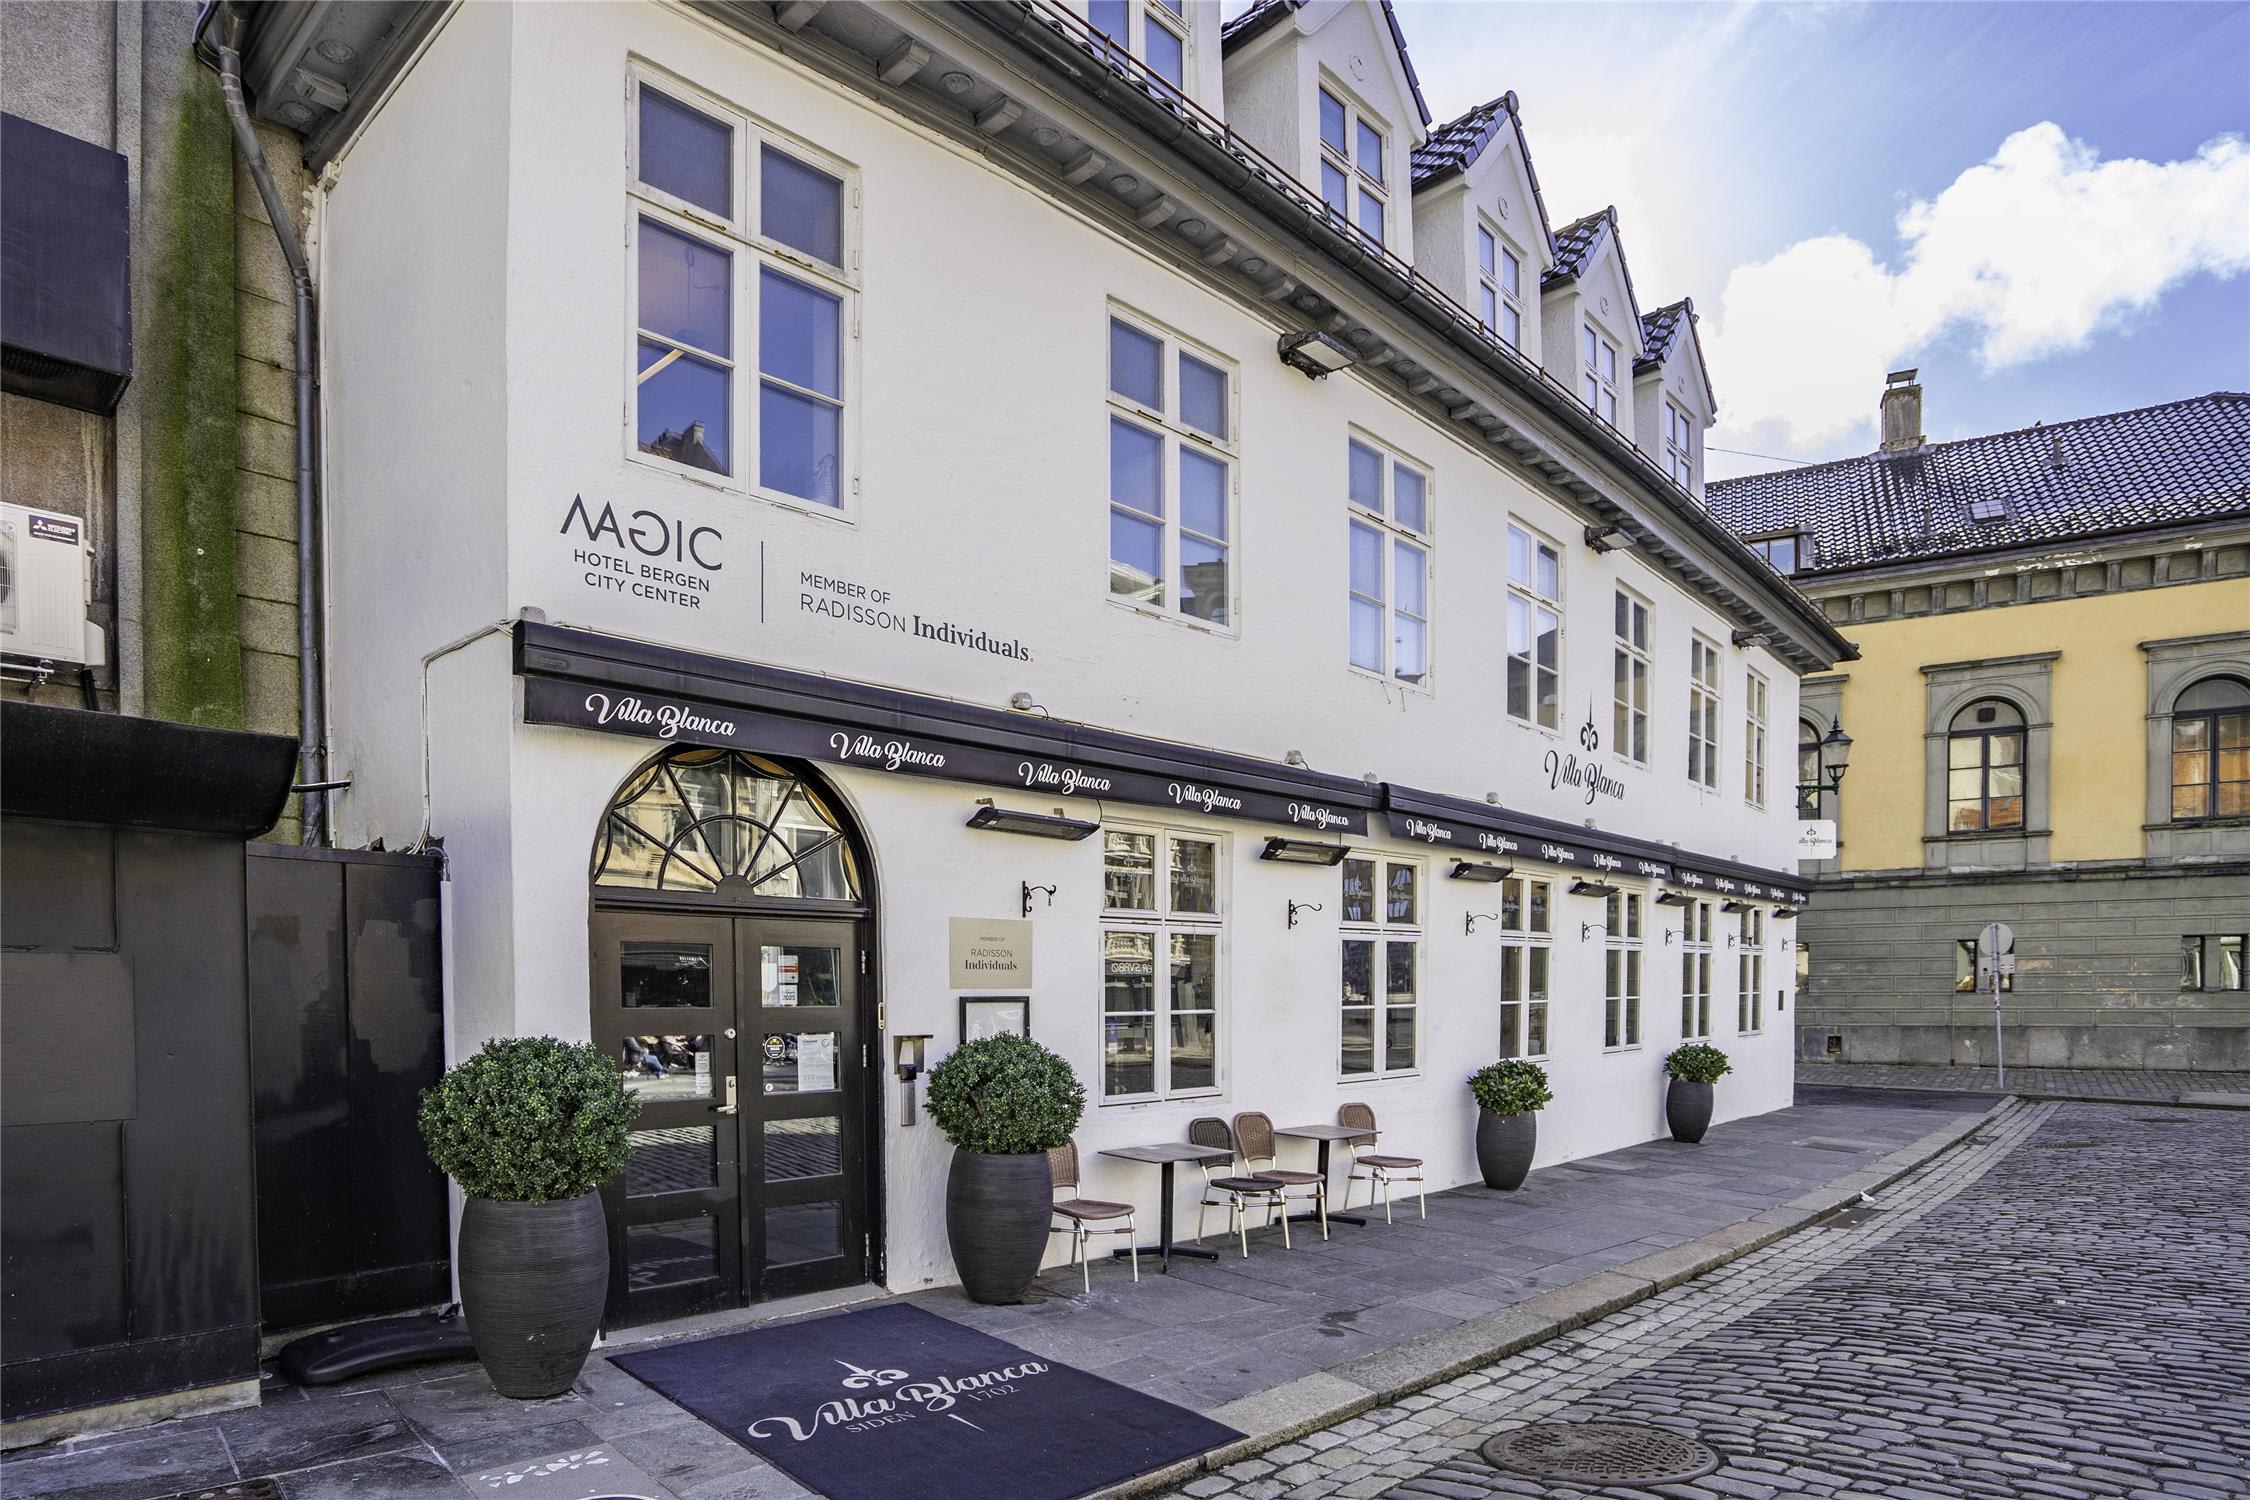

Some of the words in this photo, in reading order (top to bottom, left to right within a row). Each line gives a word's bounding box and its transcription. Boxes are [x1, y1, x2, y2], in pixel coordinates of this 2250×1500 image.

[560, 493, 722, 571] MAGIC
[574, 549, 634, 575] HOTEL
[641, 564, 710, 592] BERGEN
[585, 572, 626, 592] CITY
[632, 583, 700, 609] CENTER
[800, 571, 866, 600] MEMBER
[870, 589, 891, 604] OF
[800, 593, 906, 633] RADISSON
[585, 693, 655, 724] Villa
[656, 705, 736, 738] Blanca
[830, 732, 883, 759] Villa
[884, 741, 946, 770] Blanca
[1018, 762, 1060, 786] Villa
[1061, 768, 1111, 795] Blanca
[1544, 749, 1581, 790] Villa
[1584, 762, 1625, 805] Blanca
[1168, 783, 1202, 804] Villa
[1202, 789, 1242, 812] Blanca
[1288, 802, 1316, 823] Villa
[1316, 808, 1349, 829] Blanca
[1406, 819, 1426, 836] Villa
[1427, 823, 1452, 843] Blanca
[1479, 832, 1497, 849] Villa
[1497, 836, 1518, 854] Blanca
[965, 959, 1018, 971] Individuals
[970, 948, 1013, 958] RADISSON
[748, 1398, 896, 1442] Villa
[896, 1360, 1049, 1412] Blanca
[968, 1384, 1021, 1402] 1702
[845, 1411, 917, 1433] SIDEN
